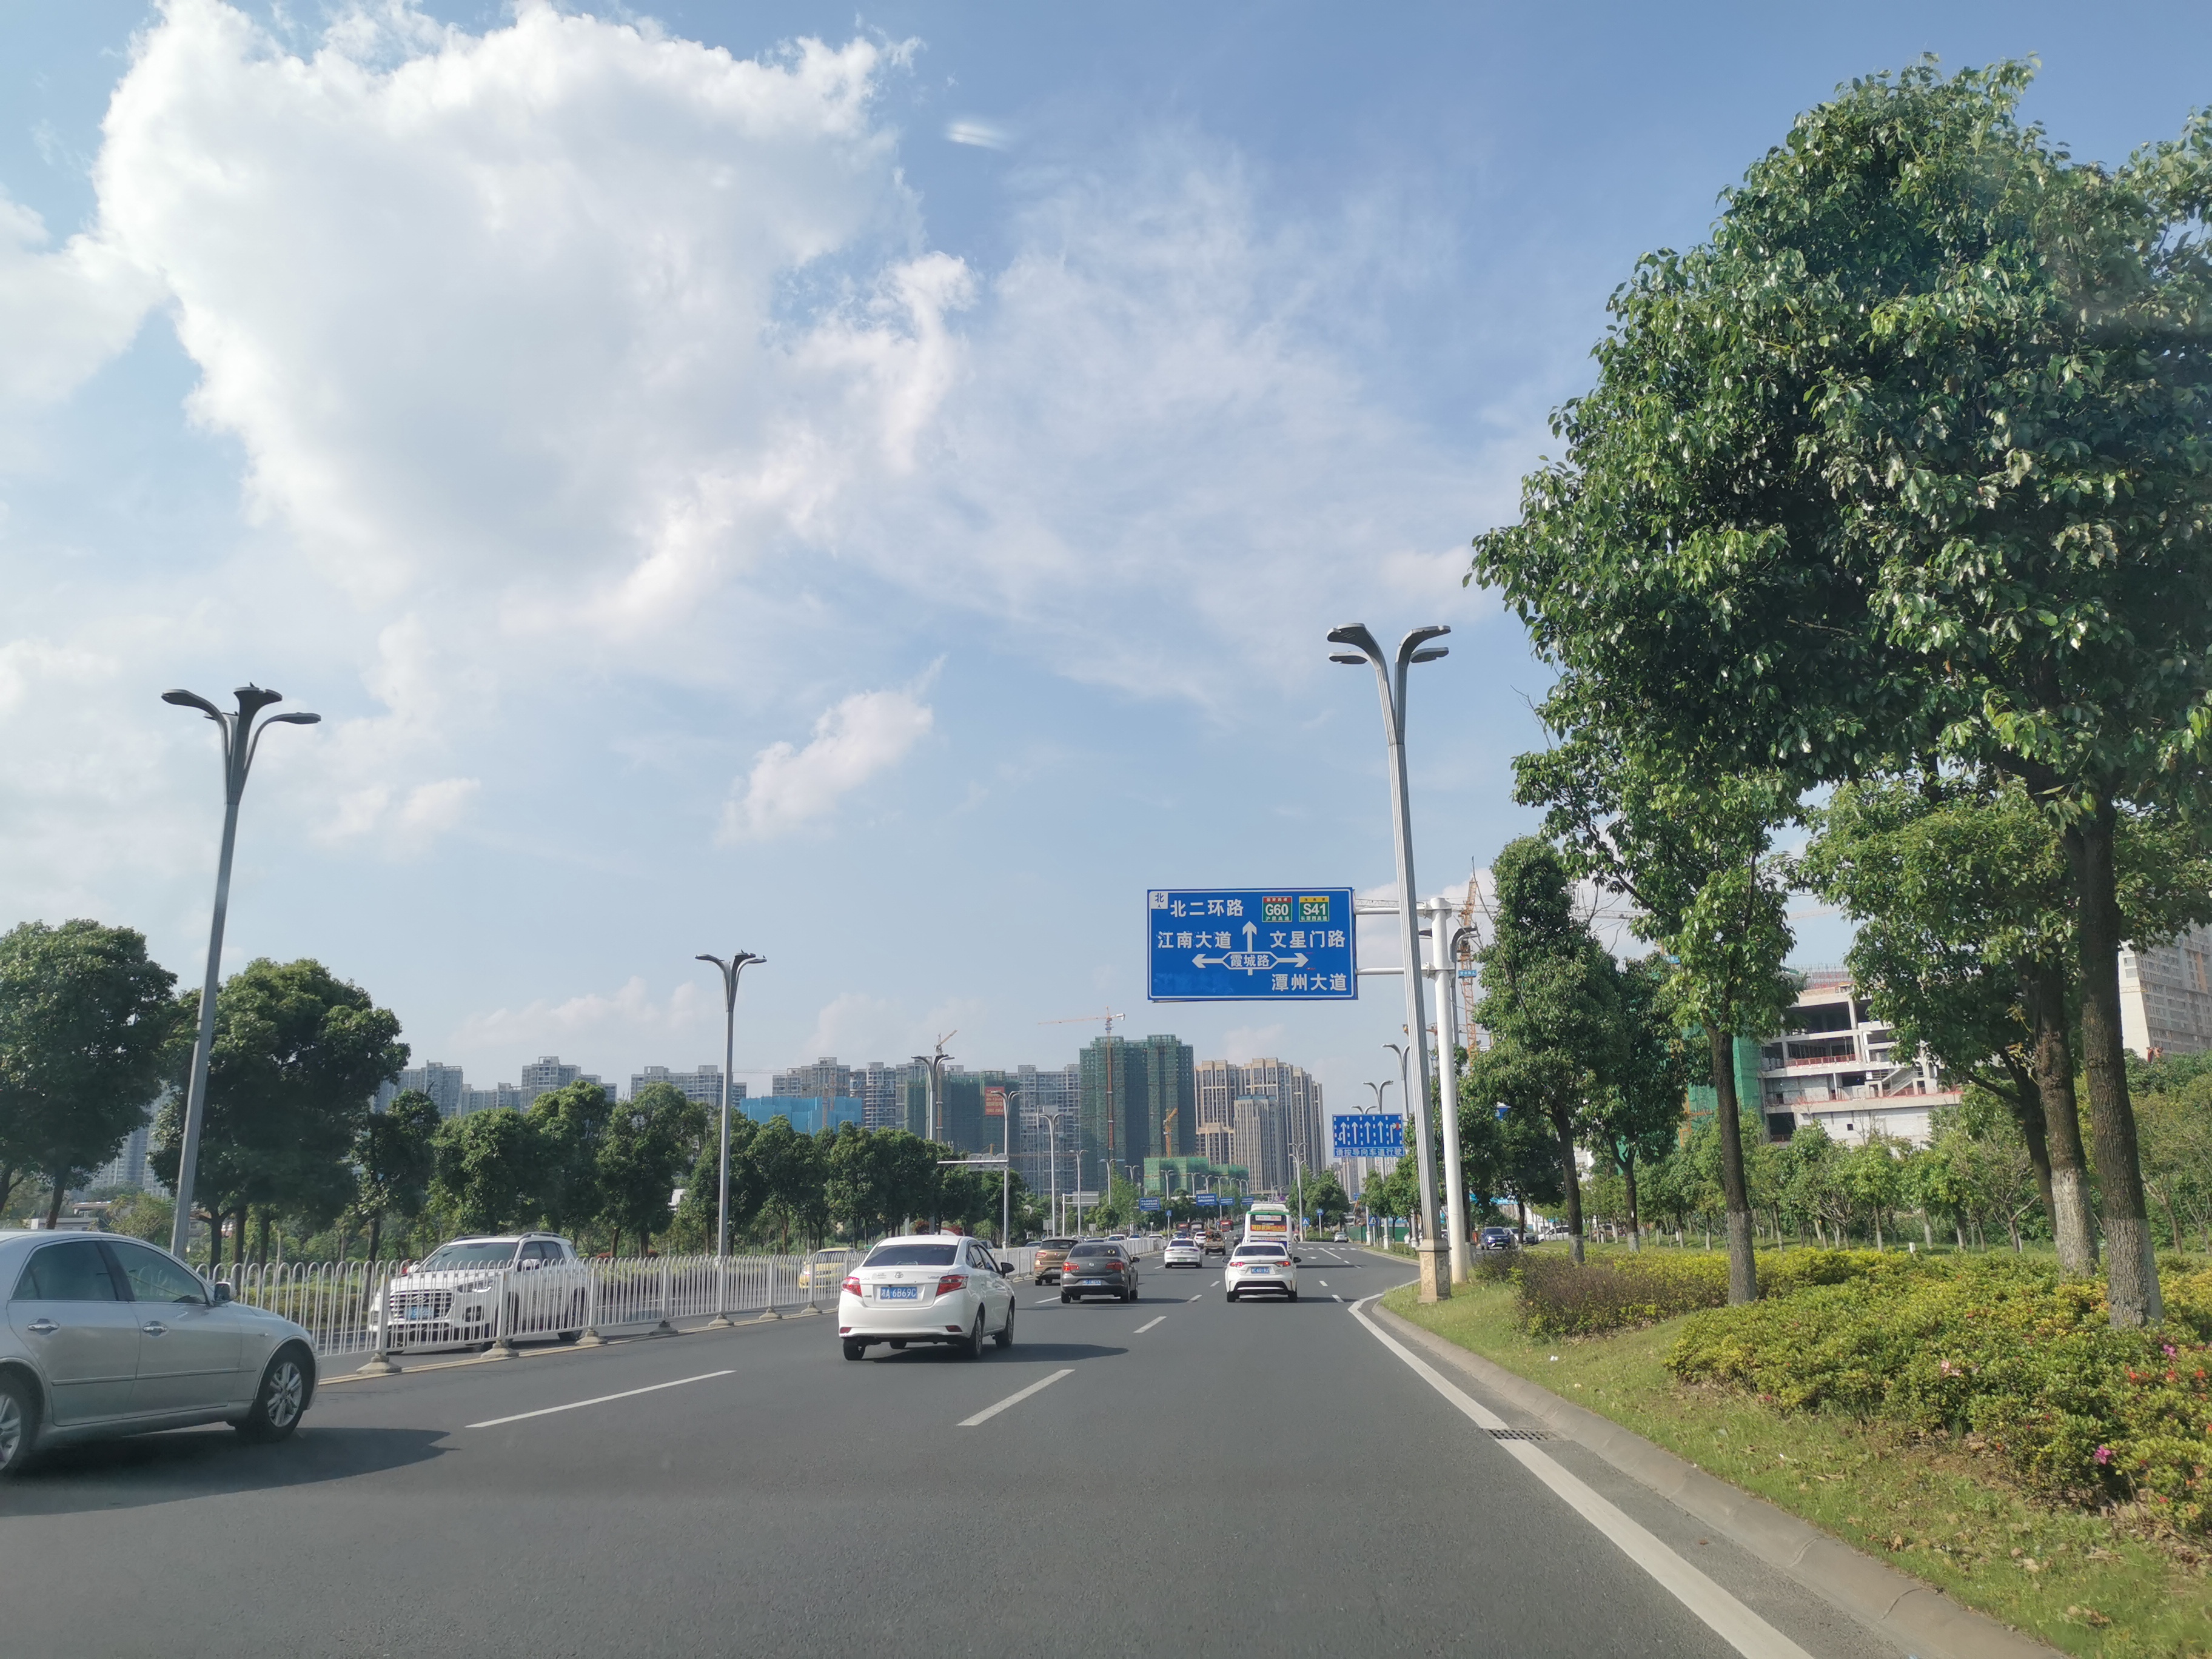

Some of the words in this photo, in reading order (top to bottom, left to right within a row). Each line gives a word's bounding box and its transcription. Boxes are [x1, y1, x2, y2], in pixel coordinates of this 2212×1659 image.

[1170, 899, 1244, 917] 北二环路
[1265, 903, 1289, 916] G60
[1303, 903, 1326, 916] S41
[1157, 931, 1232, 949] 江南大道
[1270, 930, 1346, 948] 文星门路
[1230, 954, 1270, 968] 霞城路
[1272, 973, 1347, 991] 潭州大道
